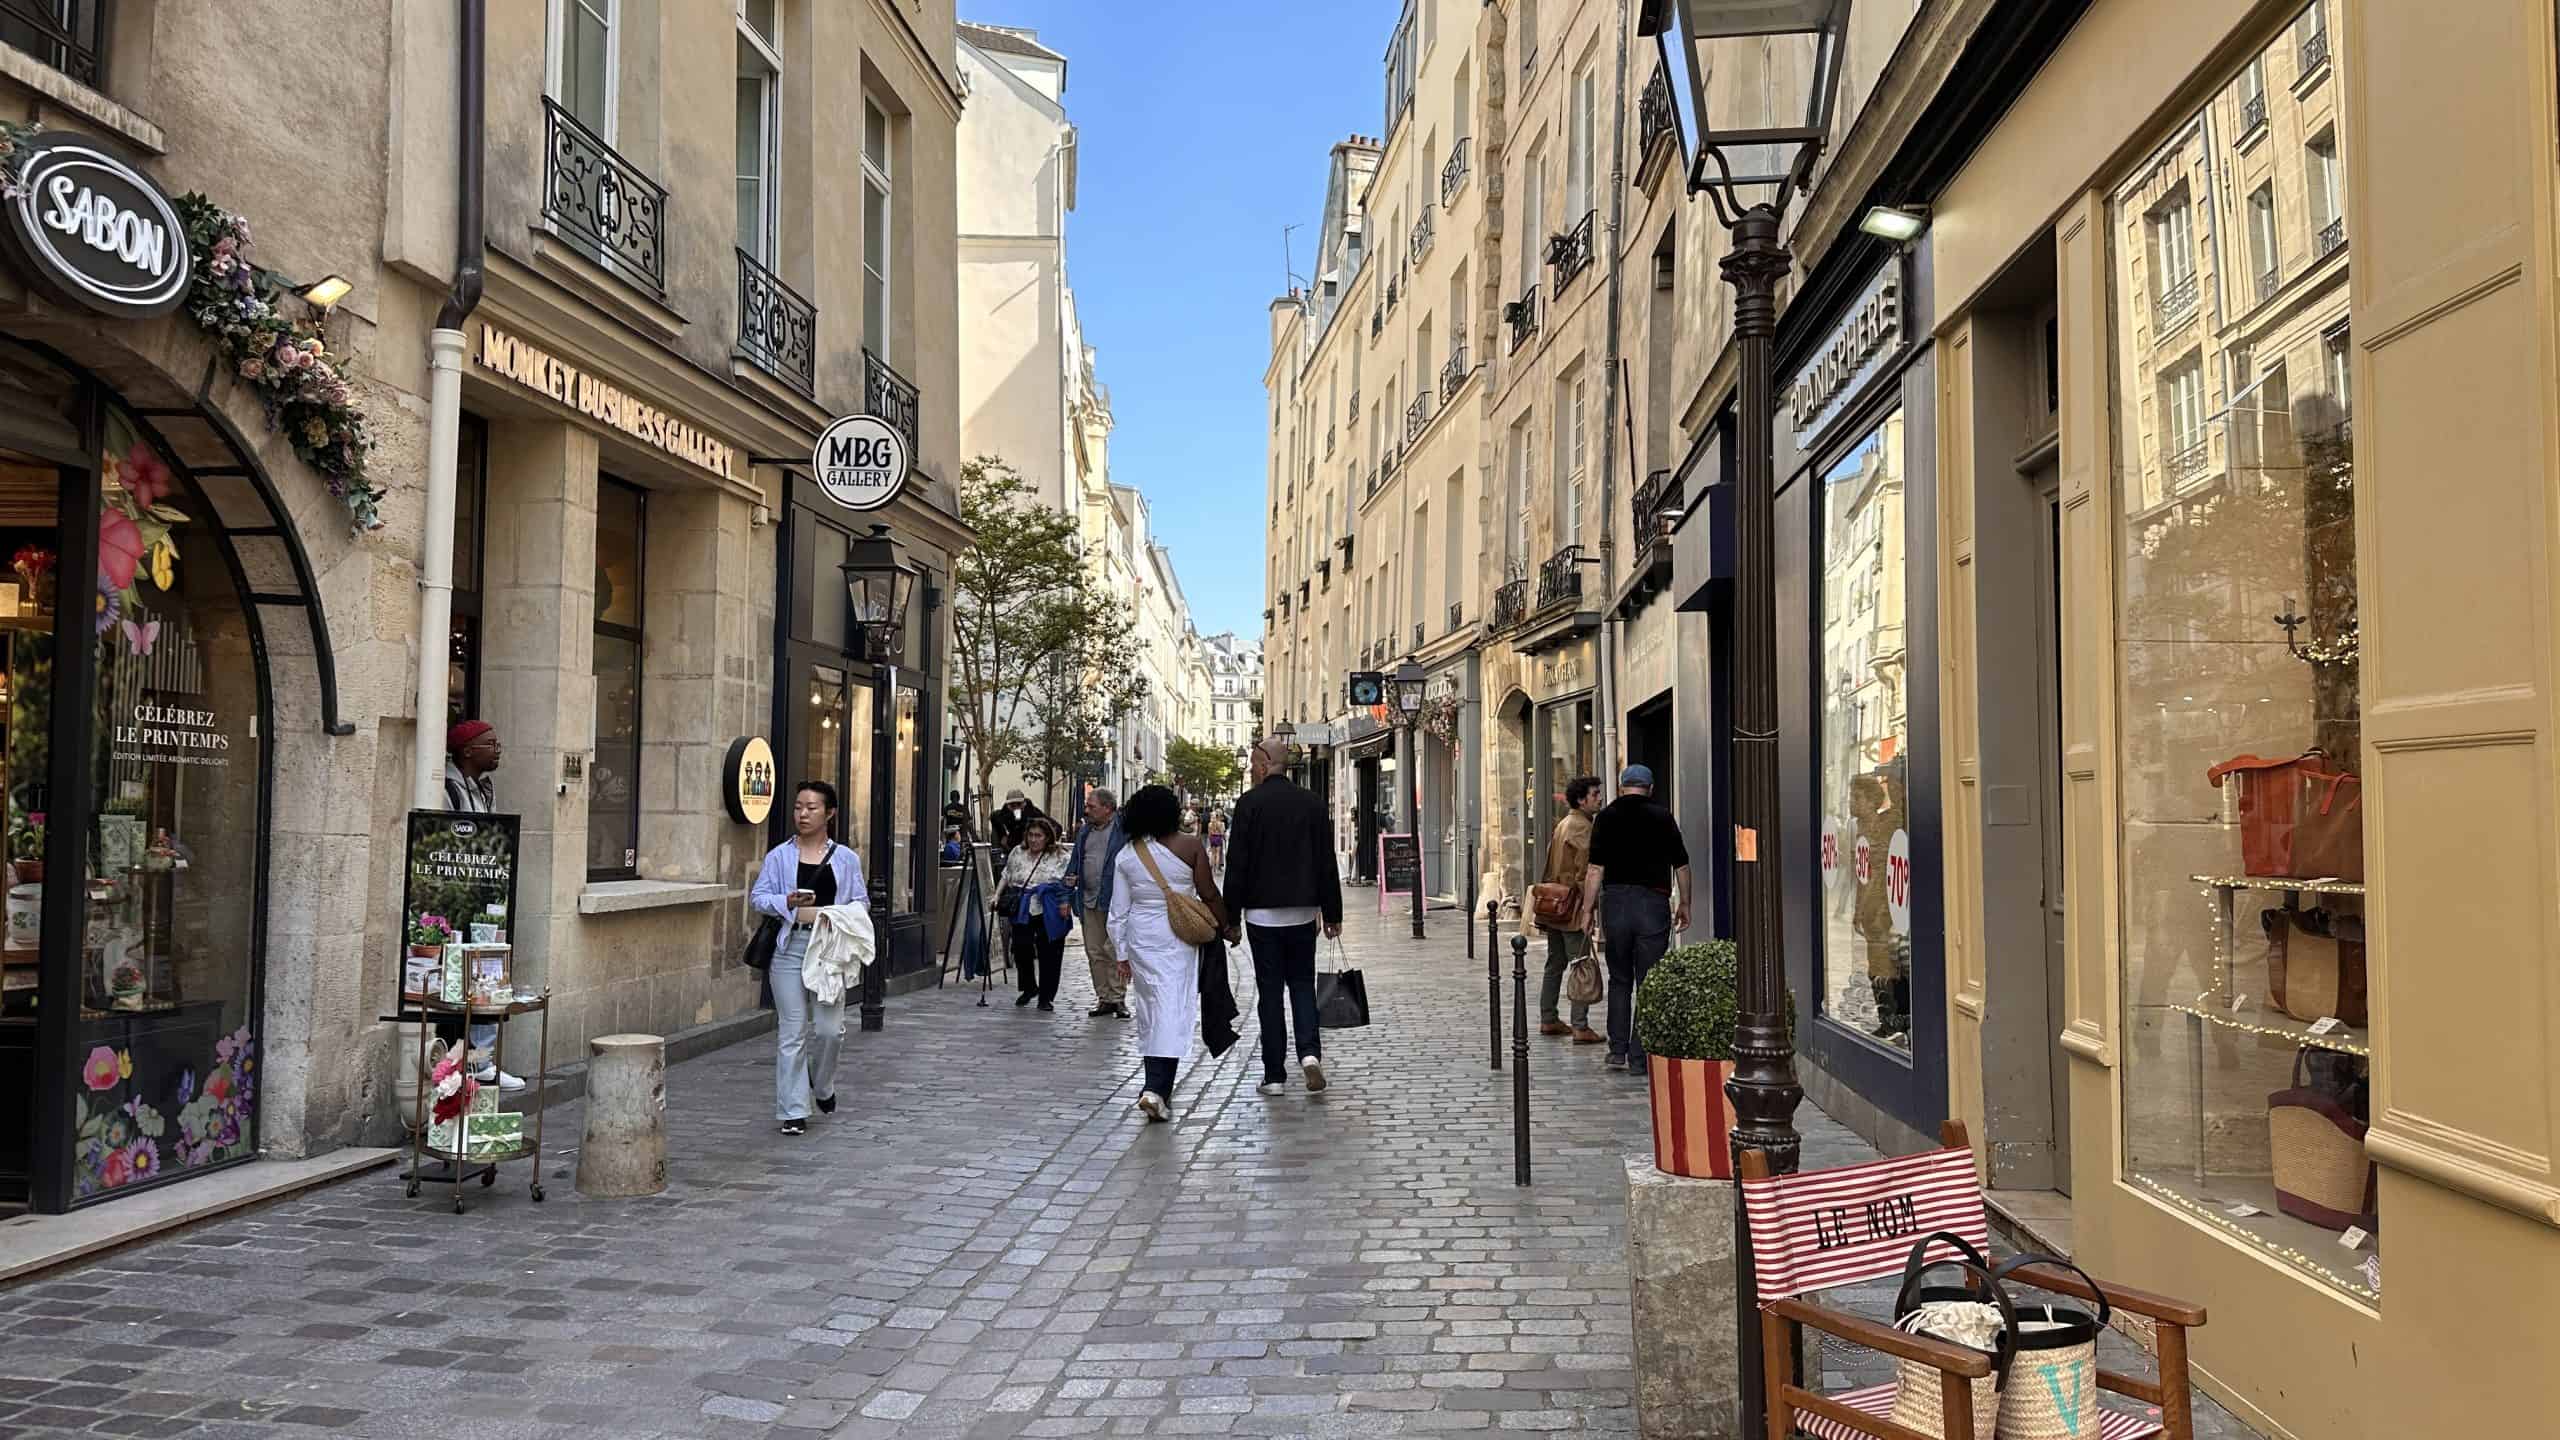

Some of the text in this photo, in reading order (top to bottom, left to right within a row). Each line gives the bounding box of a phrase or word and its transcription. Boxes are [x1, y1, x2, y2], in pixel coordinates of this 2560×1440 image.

[43, 176, 164, 276] SABON
[1790, 278, 1897, 432] PLANISPHERE
[481, 323, 734, 479] MONKEY BUSINESS GALLERY
[828, 436, 892, 468] MBG
[827, 471, 891, 487] GALLERY
[134, 702, 215, 727] CÉLÉBREZ
[116, 726, 229, 750] LE PRINTEMPS
[113, 752, 141, 761] ÉDITION
[142, 753, 167, 763] LIMITÉE
[429, 848, 497, 866] CÉLÉBREZ
[416, 864, 509, 880] LE PRINTEMPS
[1812, 1194, 1919, 1249] LE NOM
[2037, 1360, 2084, 1436] V
